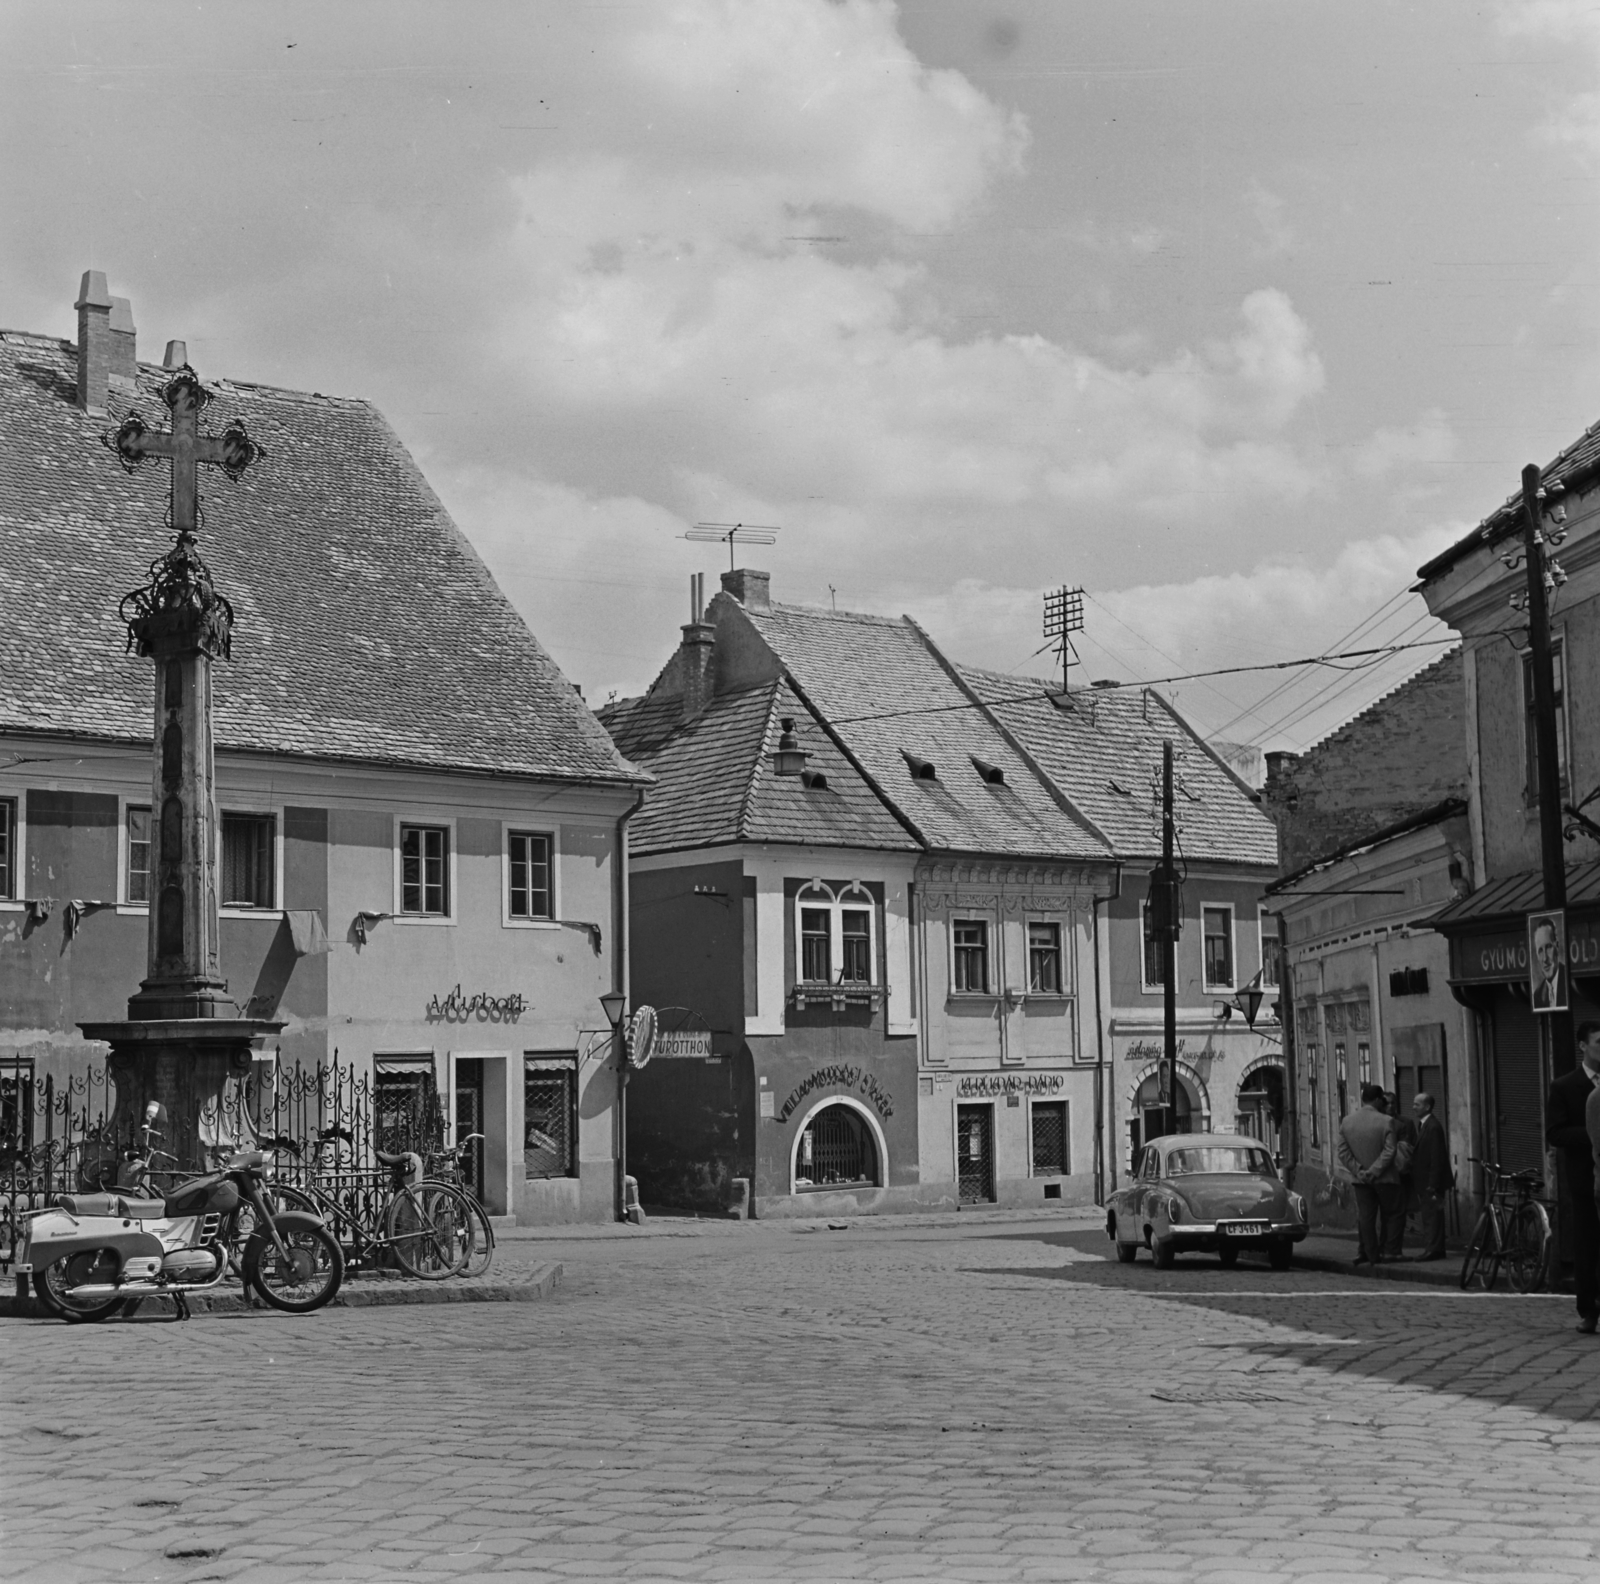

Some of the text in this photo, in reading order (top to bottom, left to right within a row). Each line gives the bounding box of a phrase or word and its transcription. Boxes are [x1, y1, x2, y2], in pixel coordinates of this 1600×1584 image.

[1480, 935, 1599, 971] GYÜMÖ ÖLD
[653, 1040, 711, 1055] TUROTTHON
